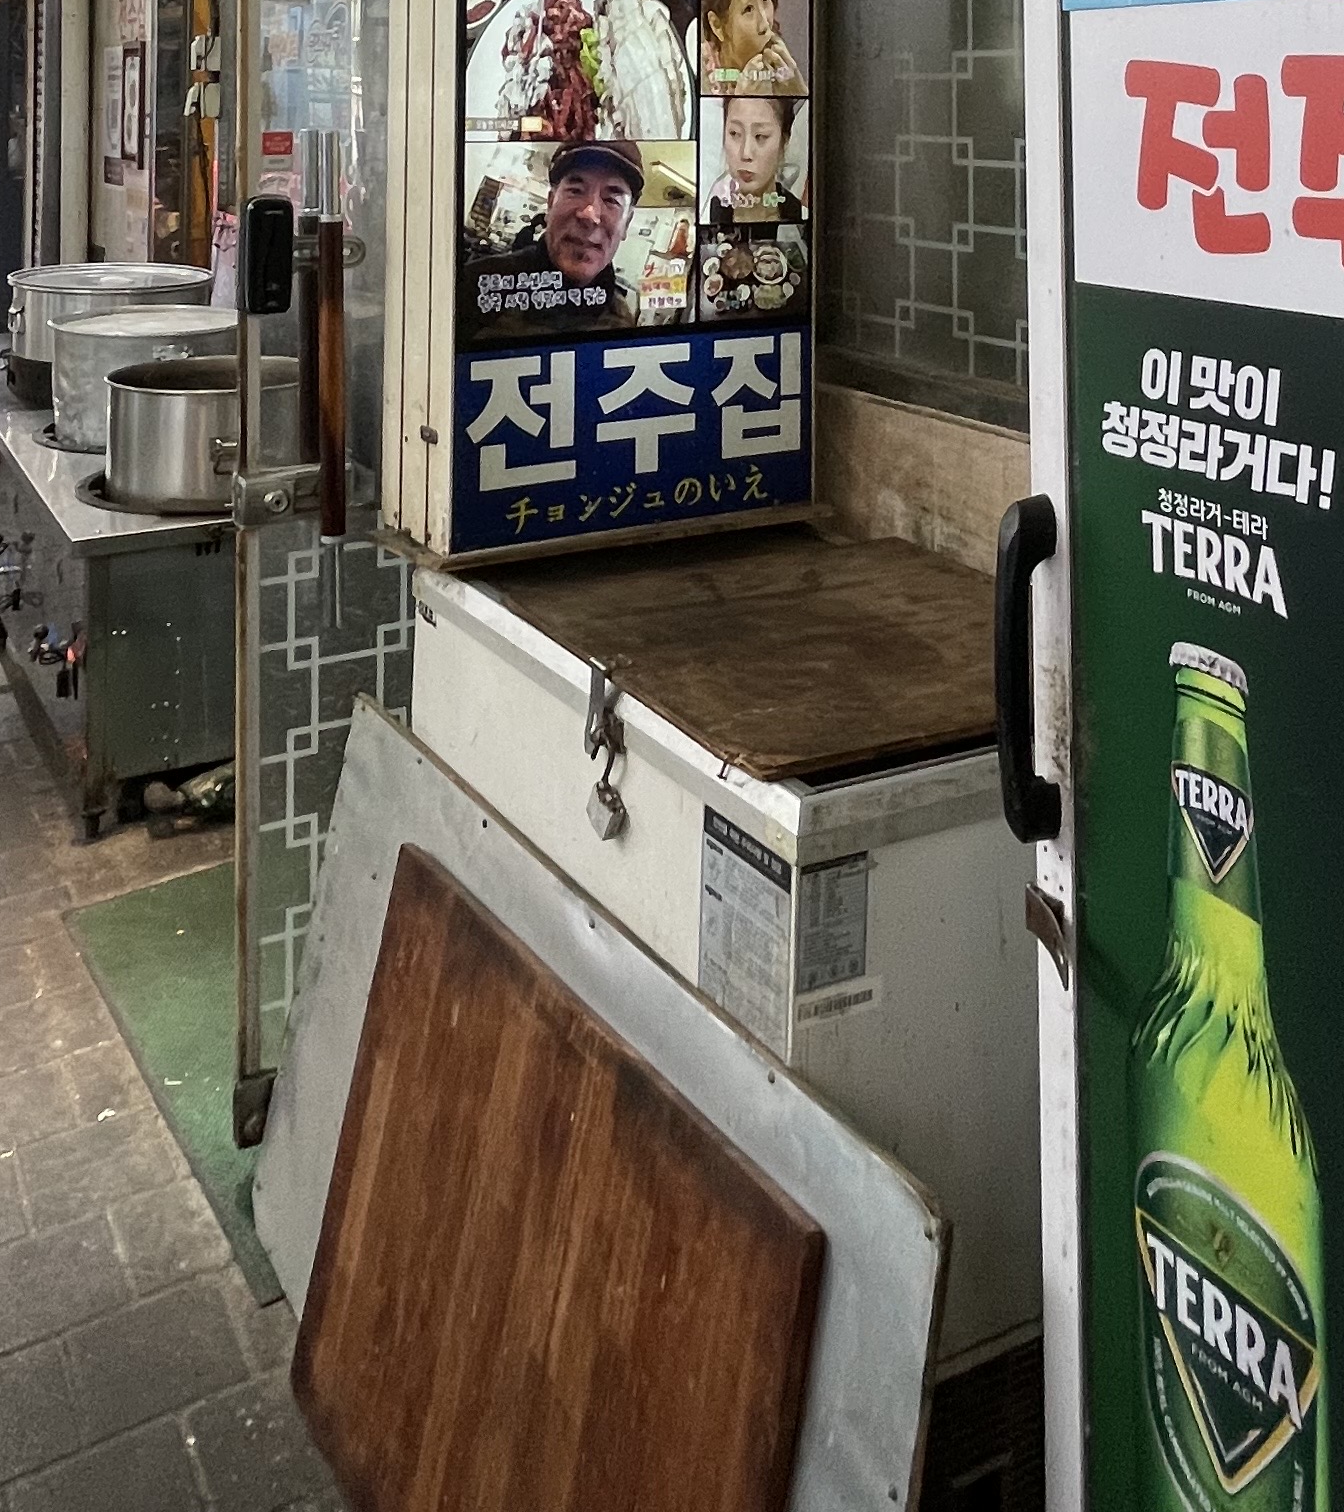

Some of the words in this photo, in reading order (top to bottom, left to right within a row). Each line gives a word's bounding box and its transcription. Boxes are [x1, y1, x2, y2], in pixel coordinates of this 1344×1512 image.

[464, 331, 802, 493] 전주집
[1141, 348, 1184, 405] 이
[1190, 355, 1281, 427] 맛이
[1101, 402, 1337, 509] 청정라거다!
[1141, 510, 1289, 620] TERRA
[1186, 588, 1216, 607] FROM
[1217, 599, 1242, 616] AGM
[1175, 768, 1250, 841] TERRA
[1146, 1231, 1303, 1430] TERRA
[1191, 1342, 1229, 1383] FROM
